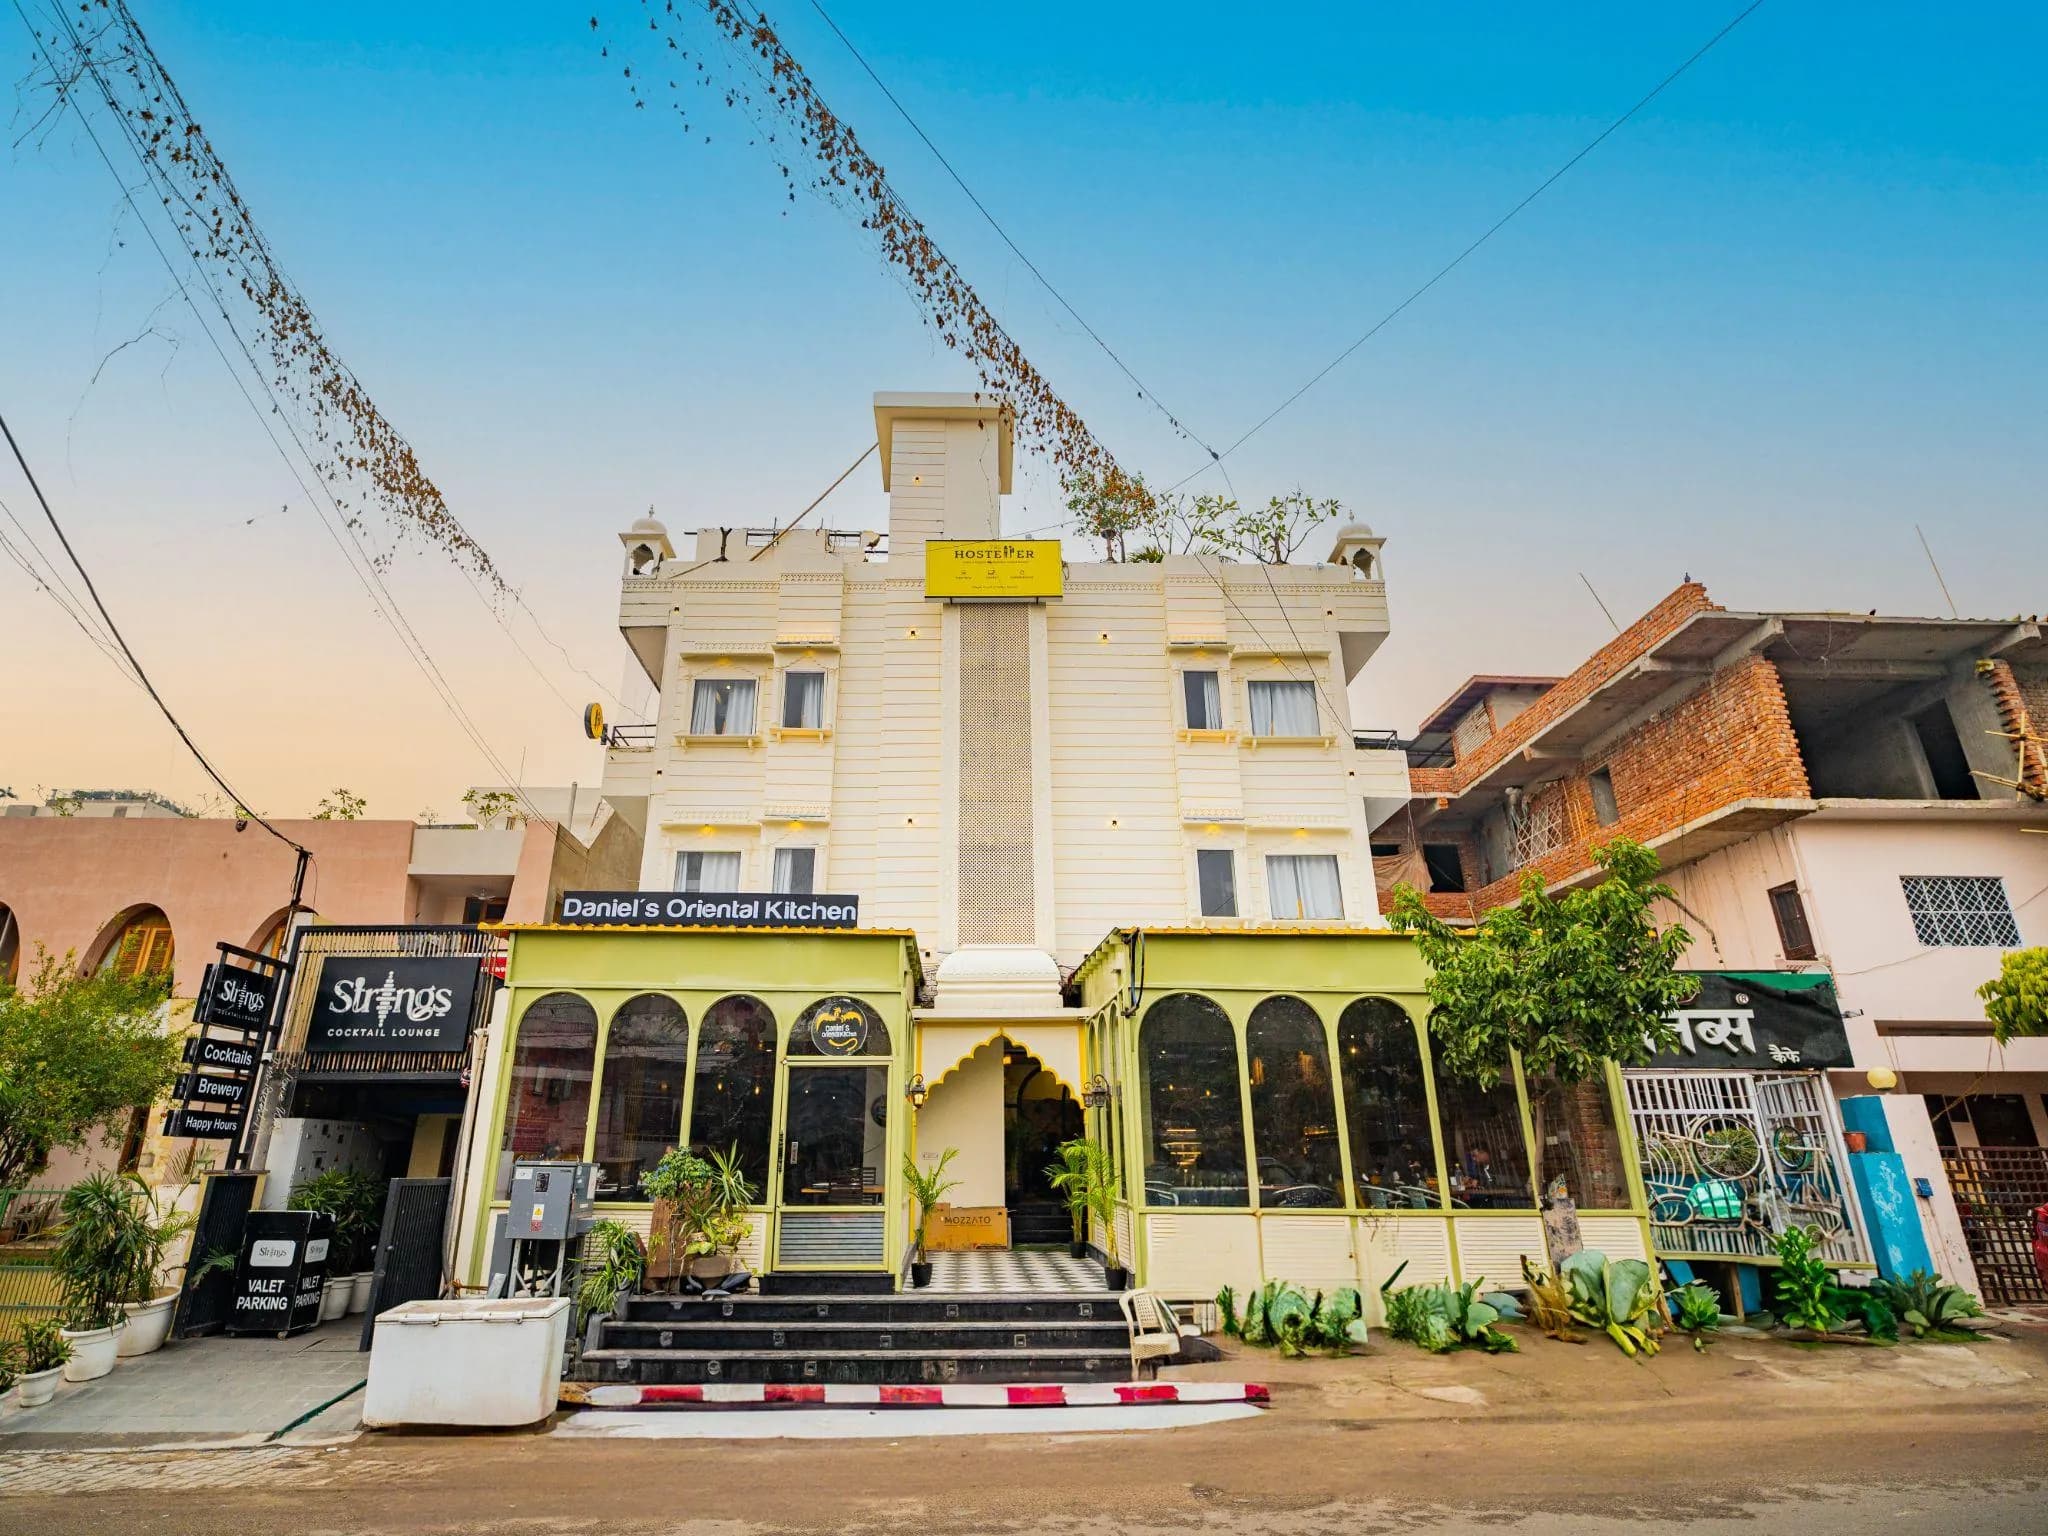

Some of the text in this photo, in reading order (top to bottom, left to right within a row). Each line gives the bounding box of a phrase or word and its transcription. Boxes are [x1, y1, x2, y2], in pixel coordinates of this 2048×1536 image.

[562, 898, 857, 921] Daniel's Oriental Kitchen
[221, 980, 265, 1012] Strings
[328, 971, 452, 1027] Strings
[327, 1028, 441, 1037] COCKTAIL LOUNGE
[204, 1044, 252, 1065] Cocktails
[198, 1078, 243, 1101] Brewery
[185, 1116, 238, 1131] Happy Hours
[944, 1216, 991, 1224] MOZZATO
[248, 1279, 285, 1293] VALET
[302, 1275, 320, 1290] VALET
[236, 1296, 288, 1310] PARKING
[295, 1291, 320, 1308] PARKING
